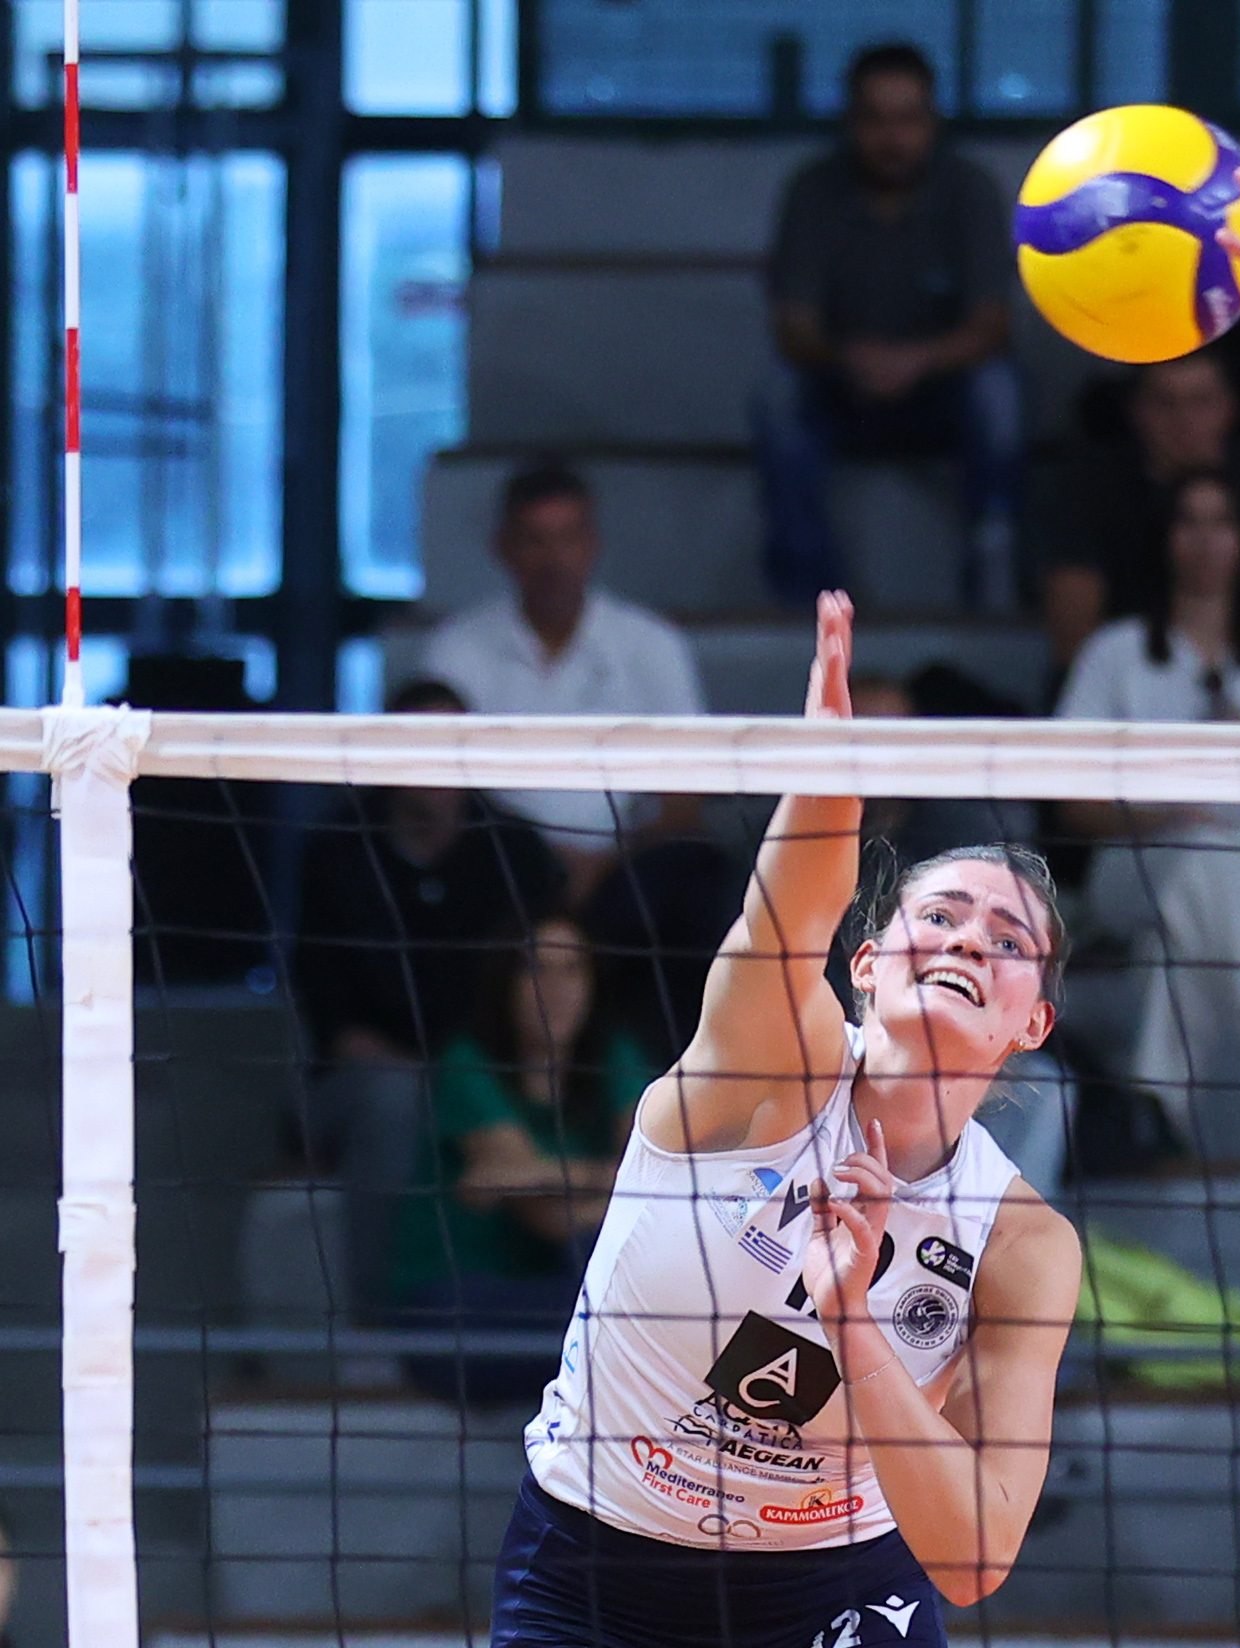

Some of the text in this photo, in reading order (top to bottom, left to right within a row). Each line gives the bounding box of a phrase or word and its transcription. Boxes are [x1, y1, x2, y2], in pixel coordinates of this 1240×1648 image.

[718, 1439, 826, 1471] AEGEAN
[642, 1471, 712, 1509] First Care
[646, 1460, 746, 1503] Mediterraneo
